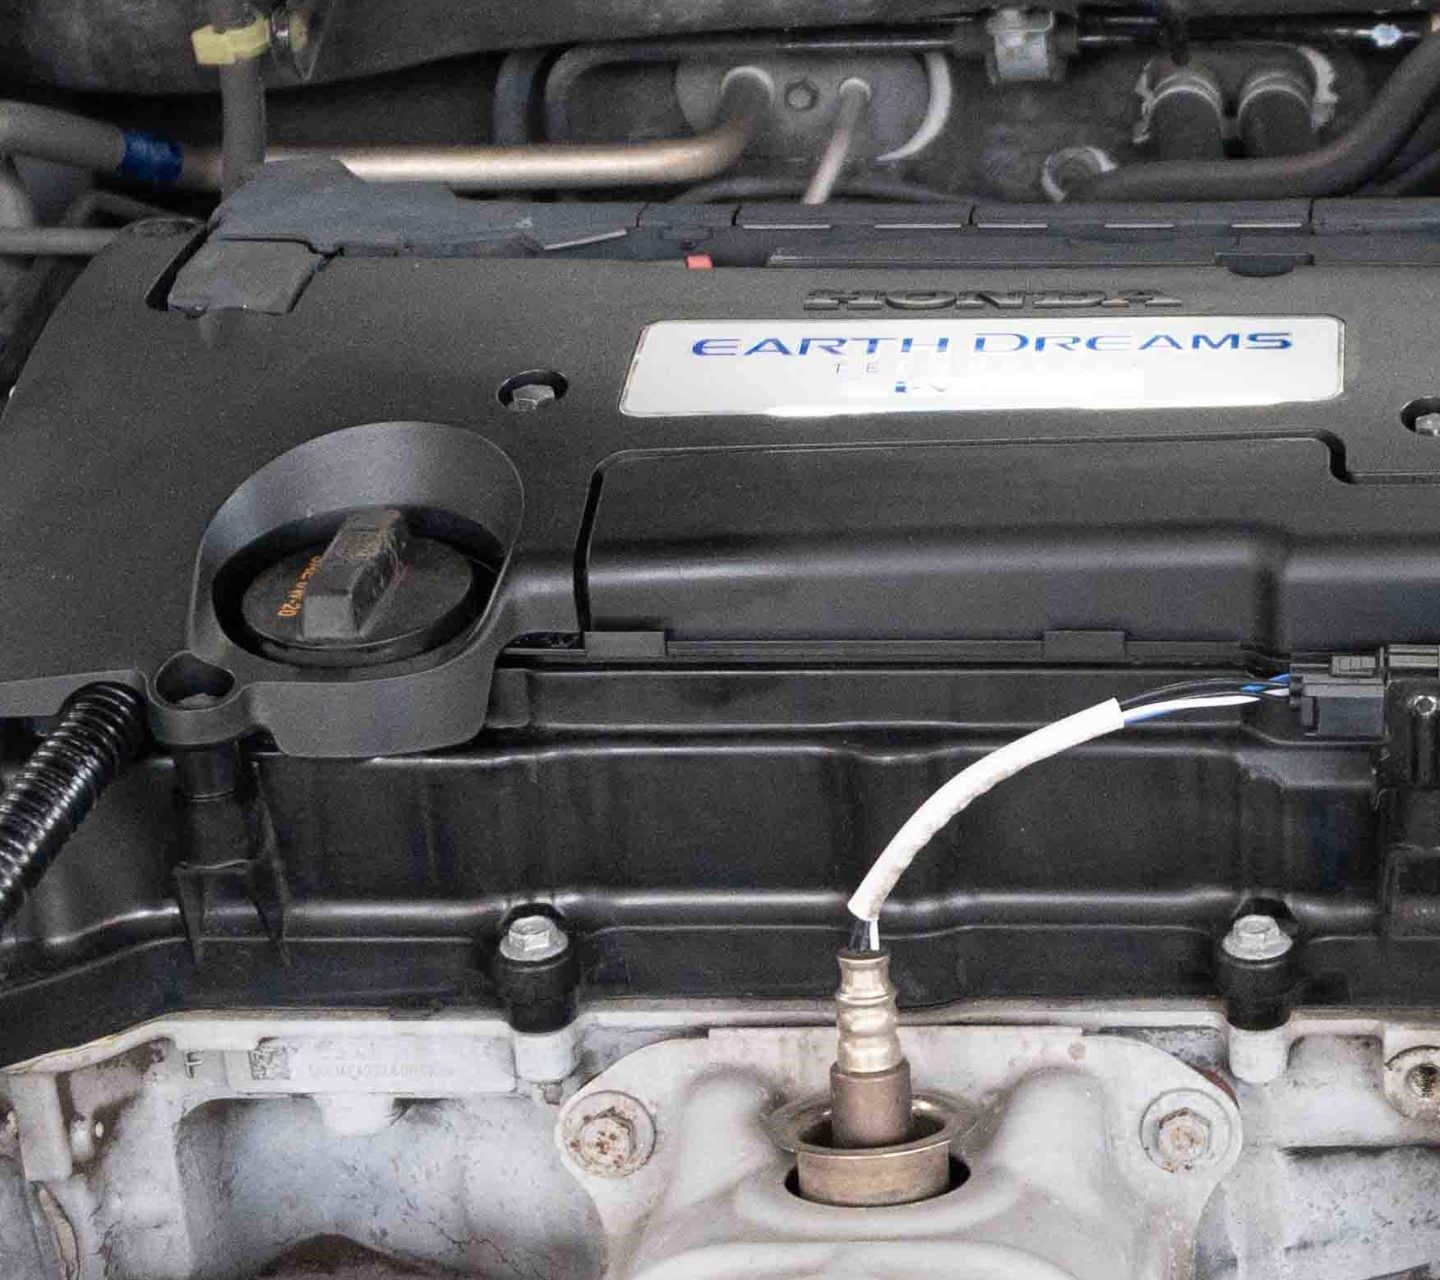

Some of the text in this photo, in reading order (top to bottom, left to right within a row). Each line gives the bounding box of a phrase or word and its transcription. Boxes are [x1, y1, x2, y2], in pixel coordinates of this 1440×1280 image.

[803, 287, 1182, 310] HONDA
[691, 330, 1292, 359] EARTH DREAMS
